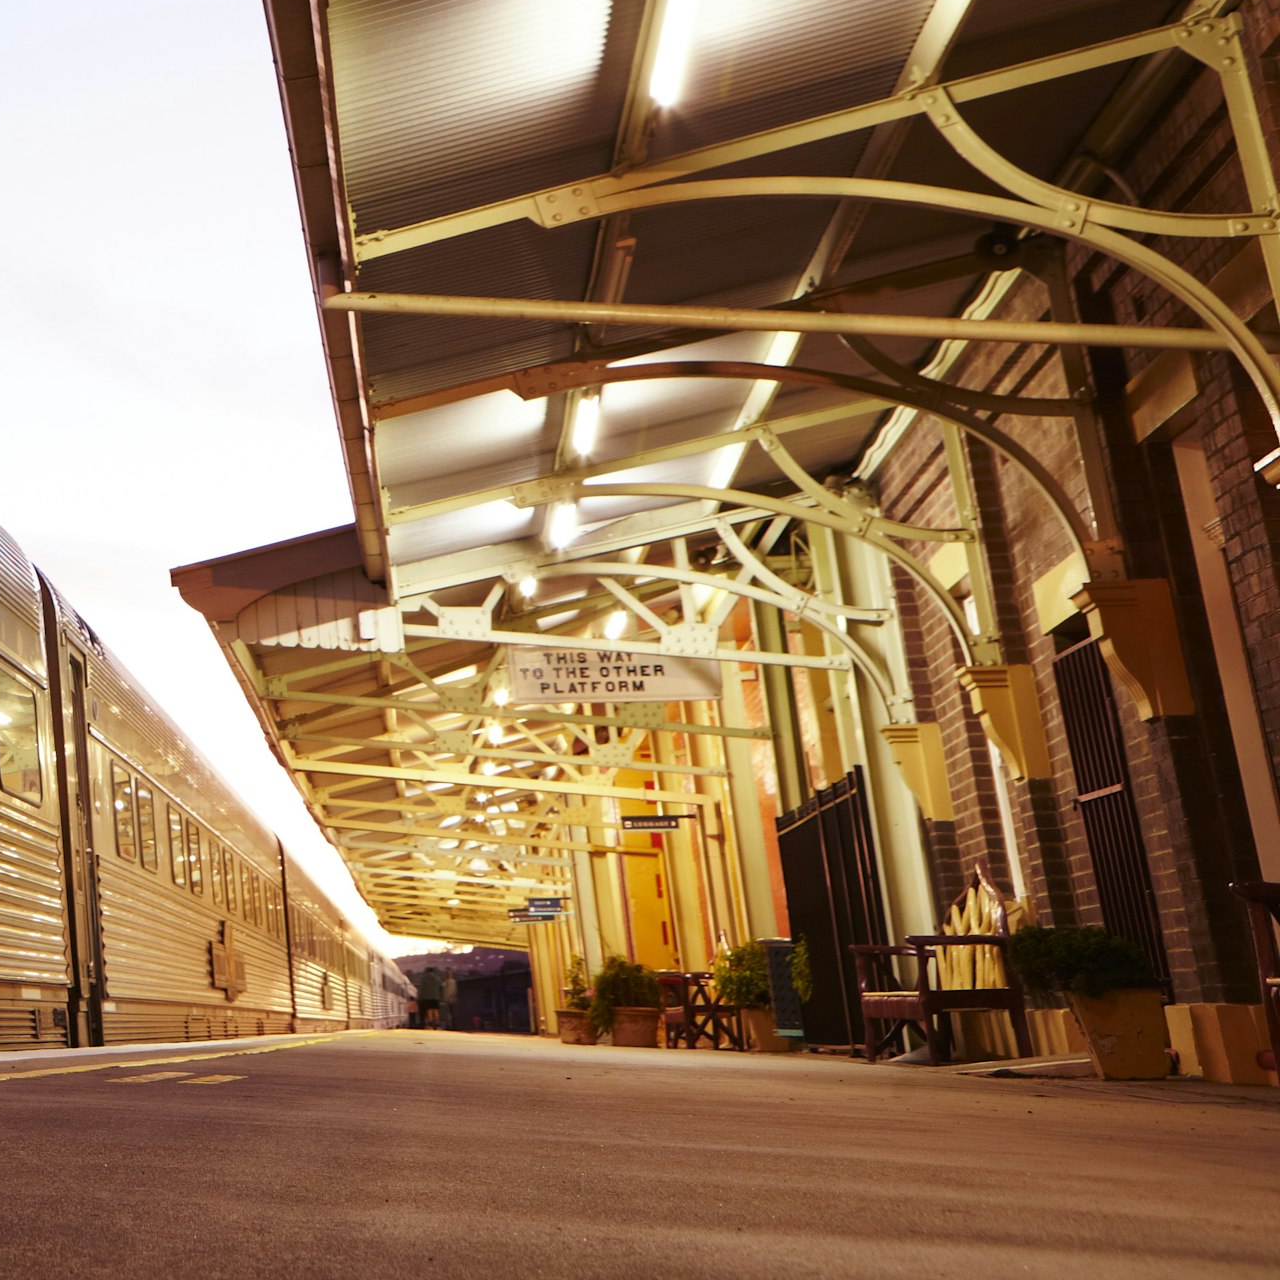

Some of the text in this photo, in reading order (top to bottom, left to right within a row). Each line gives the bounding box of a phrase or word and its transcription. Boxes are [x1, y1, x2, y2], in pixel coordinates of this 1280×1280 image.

[543, 652, 633, 665] THIS WAY
[520, 665, 665, 680] TO THE OTHER
[540, 680, 645, 694] PLATFORM
